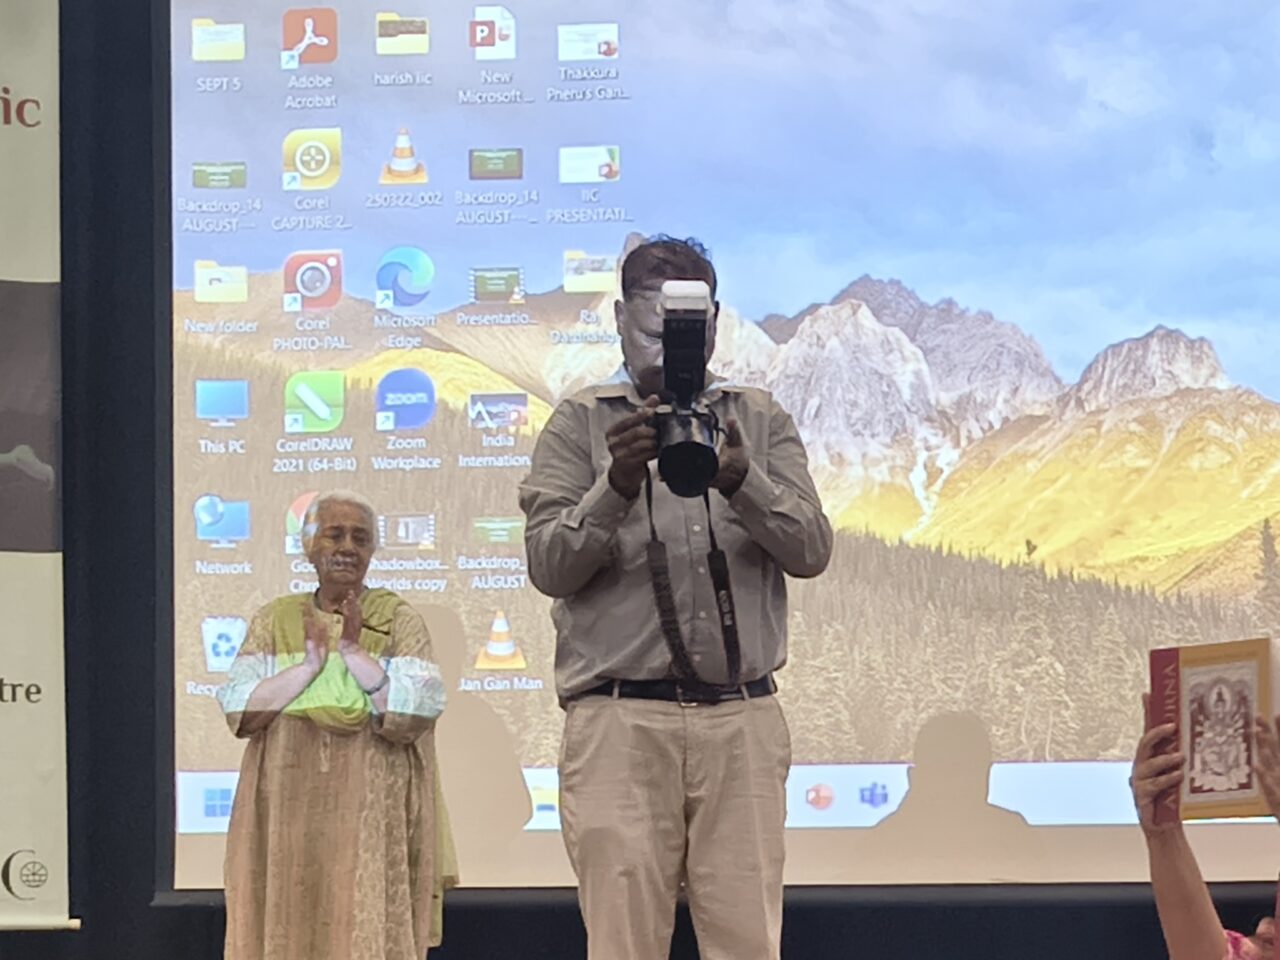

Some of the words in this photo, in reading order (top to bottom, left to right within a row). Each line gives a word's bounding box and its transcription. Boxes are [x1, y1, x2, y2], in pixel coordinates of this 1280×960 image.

[196, 77, 229, 91] SEPT
[231, 77, 242, 90] 5
[287, 74, 334, 89] Adobe
[373, 72, 414, 86] harish
[480, 70, 513, 84] New
[284, 95, 338, 109] Acrobat
[458, 89, 522, 104] Microsoft
[2, 86, 42, 128] ic
[294, 196, 329, 210] Corel
[271, 216, 332, 231] CAPTURE
[183, 319, 215, 332] New
[218, 318, 258, 332] folder
[295, 316, 330, 330] Corel
[373, 313, 437, 328] Microsoft
[387, 334, 422, 349] Edge
[198, 439, 226, 453] This
[228, 439, 246, 453] PC
[275, 437, 353, 452] CorelDRAW
[386, 436, 427, 450] Zoom
[482, 433, 516, 447] India
[272, 458, 304, 472] 2021
[371, 454, 442, 471] Workplace
[195, 560, 253, 575] Network
[414, 578, 447, 593] copy
[457, 678, 481, 692] Jan
[483, 677, 511, 690] Gan
[513, 677, 544, 690] Man
